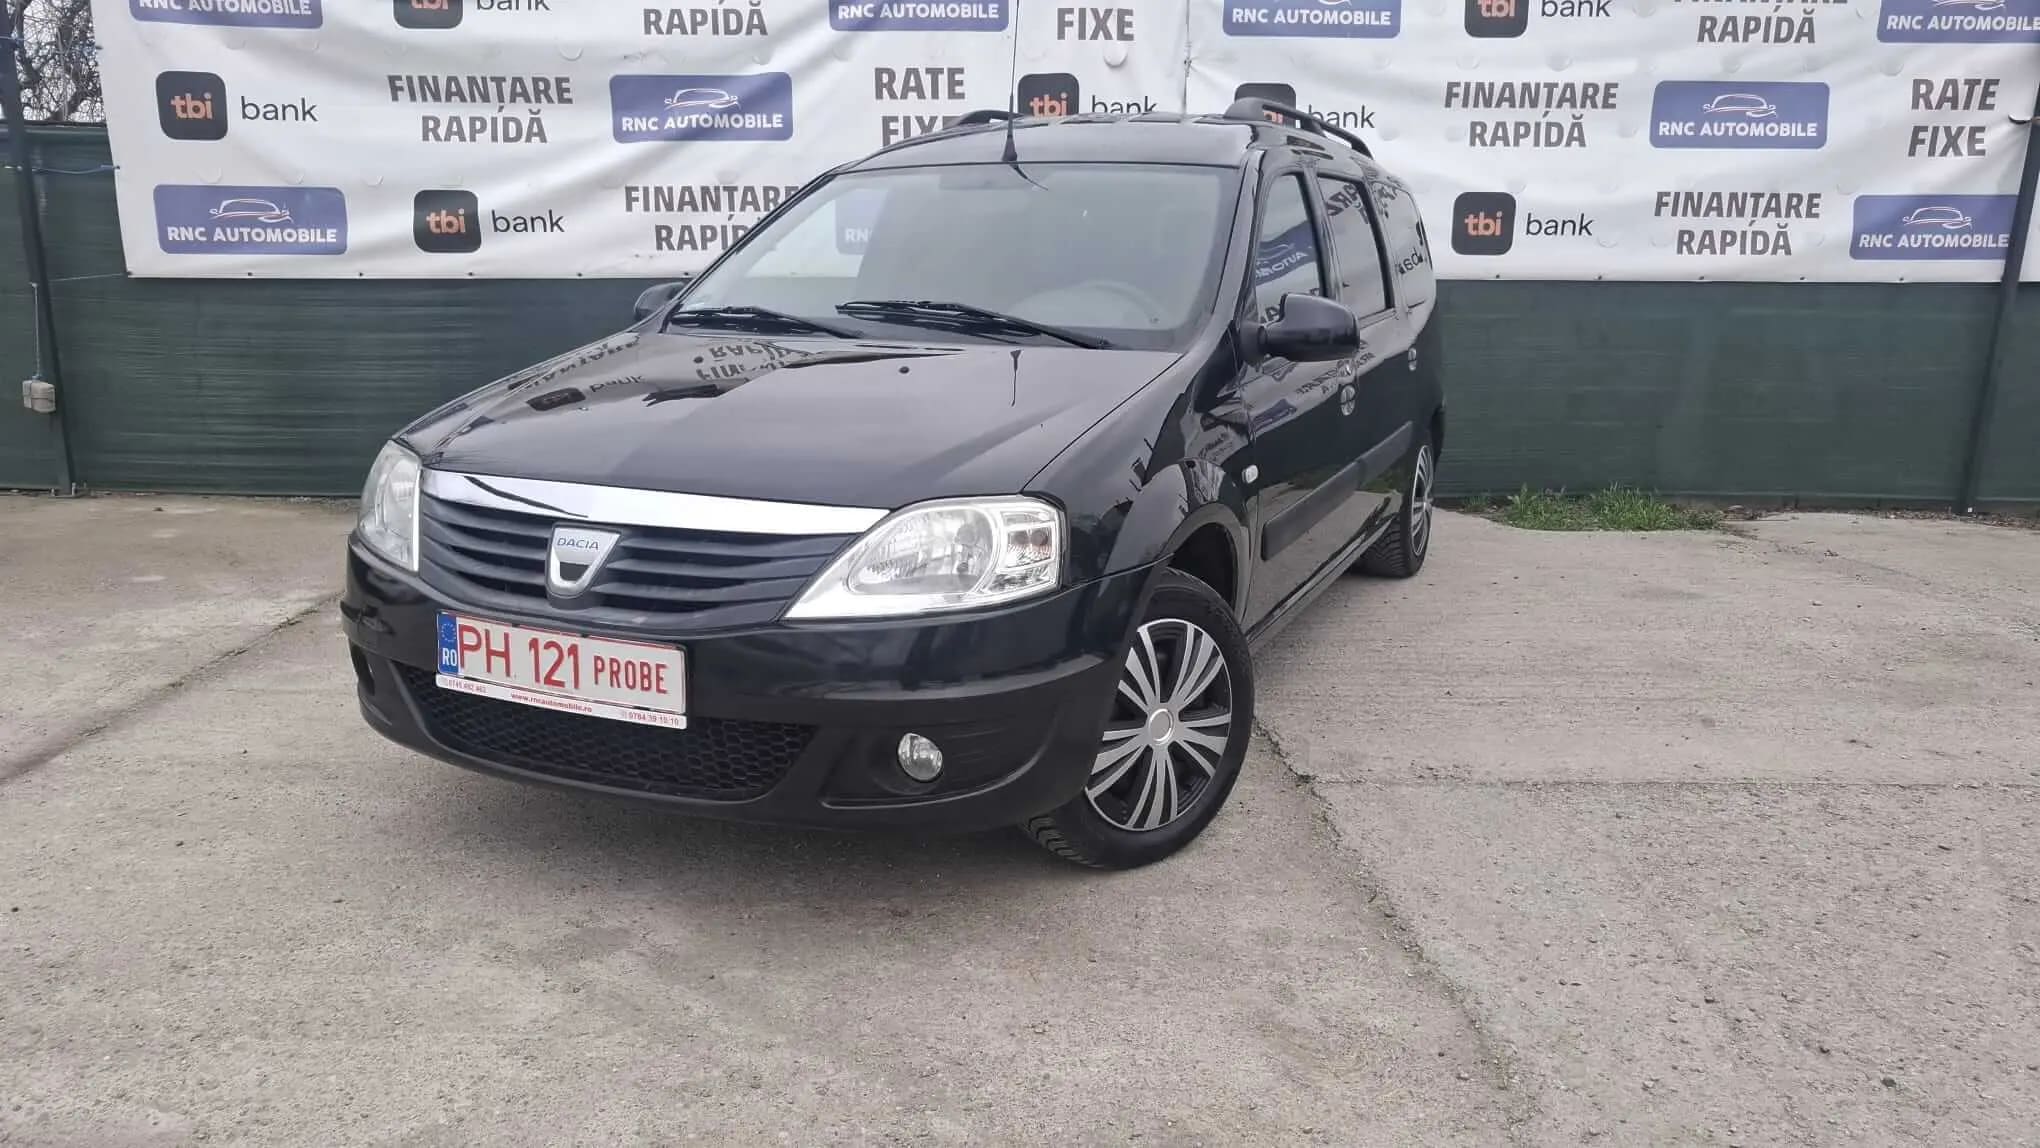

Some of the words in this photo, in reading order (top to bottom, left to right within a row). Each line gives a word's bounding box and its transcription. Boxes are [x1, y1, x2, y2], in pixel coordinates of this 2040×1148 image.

[189, 0, 312, 15] AUTOMOBILE
[838, 3, 875, 20] RNC
[880, 3, 999, 19] AUTOMOBILE
[1232, 8, 1269, 24] RNC
[1274, 9, 1392, 26] AUTOMOBILE
[1541, 0, 1611, 18] bank
[1057, 7, 1135, 41] FIXE
[1886, 15, 1923, 30] RNC
[874, 67, 966, 100] RATE
[1911, 78, 2001, 111] RATE
[170, 92, 213, 120] tbi
[240, 95, 319, 122] bank
[621, 115, 659, 132] RNC
[663, 113, 784, 130] AUTOMOBILE
[1658, 121, 1695, 136] RNC
[1700, 122, 1818, 137] AUTOMOBILE
[1907, 125, 1987, 157] FIXE
[426, 208, 466, 234] tbi
[490, 208, 566, 233] bank
[1464, 211, 1503, 237] tbi
[1525, 212, 1595, 237] bank
[167, 226, 208, 242] RNC
[213, 227, 337, 243] AUTOMOBILE
[655, 223, 754, 251] RAPID
[1858, 234, 1893, 248] RNC
[1897, 233, 2010, 249] AUTOMOBILE
[556, 537, 599, 550] DACIA
[442, 648, 458, 667] RO
[458, 623, 512, 678] PH
[528, 637, 580, 690] 121
[593, 655, 669, 695] PROBE
